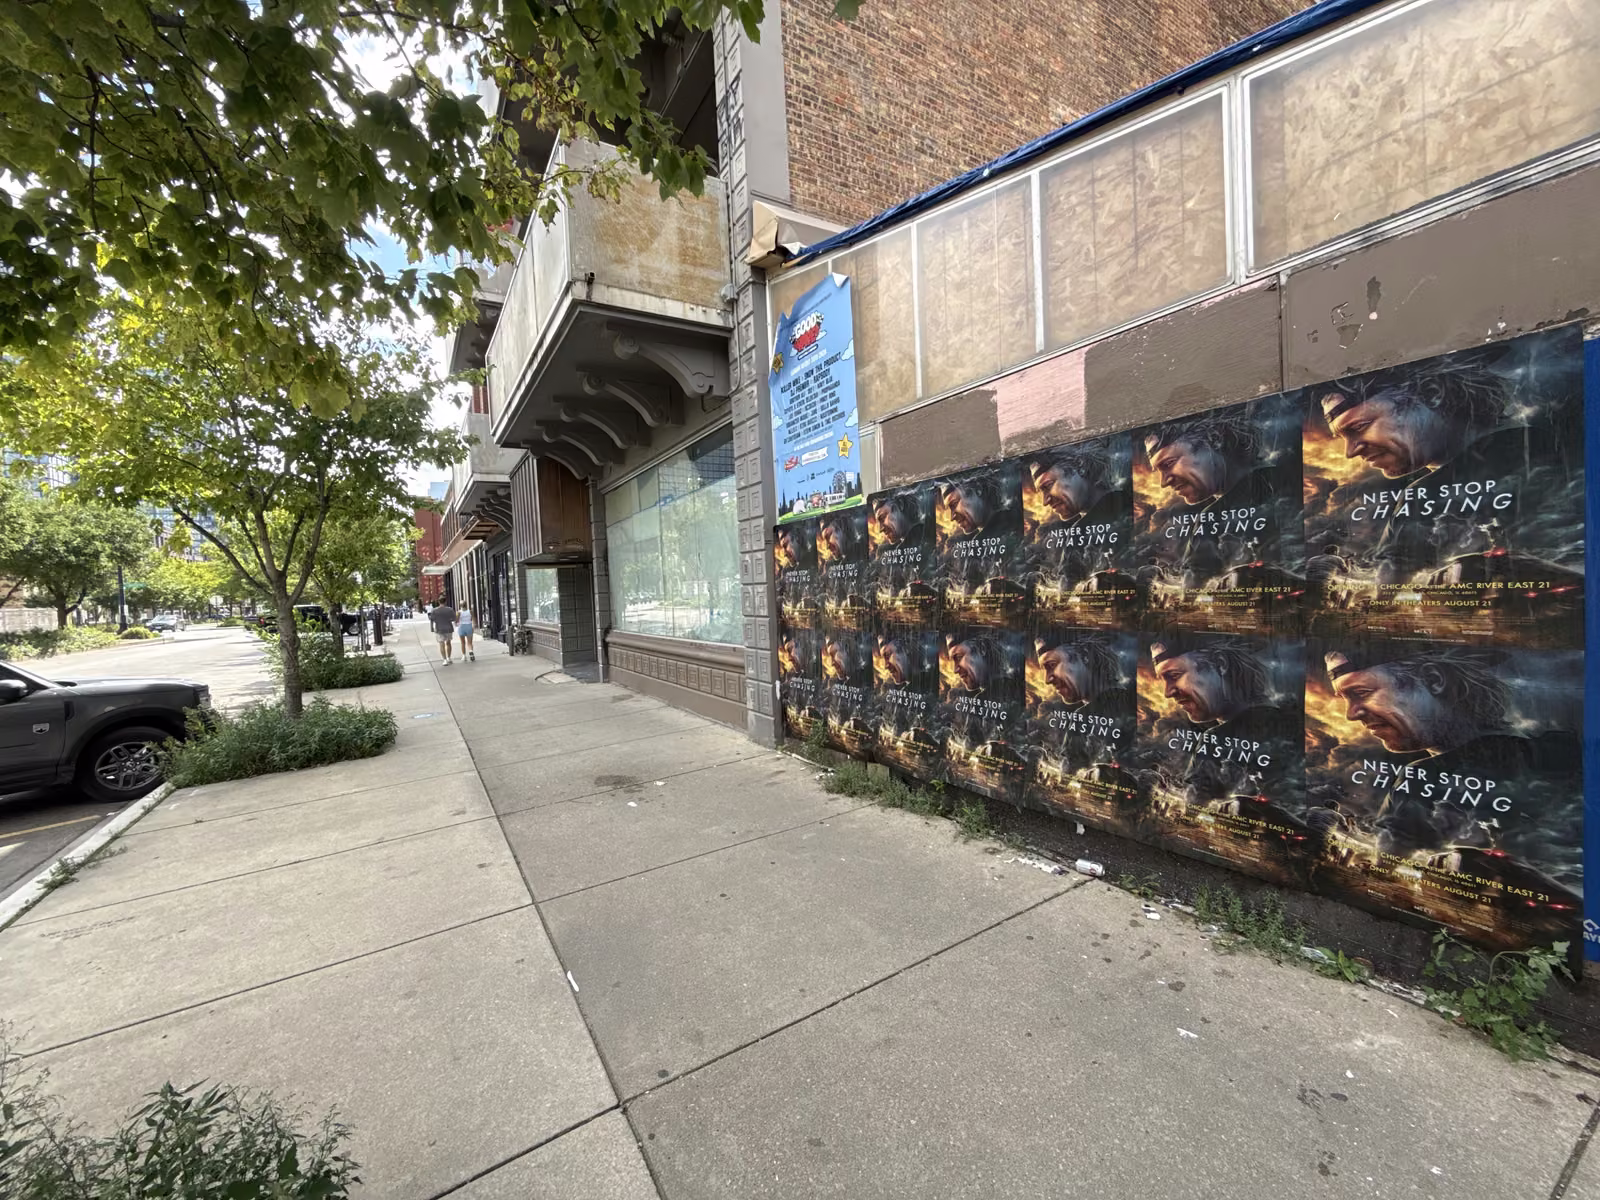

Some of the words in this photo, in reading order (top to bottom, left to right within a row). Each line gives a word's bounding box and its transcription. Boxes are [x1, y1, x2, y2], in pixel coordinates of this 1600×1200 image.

[796, 313, 816, 338] GOOD
[824, 352, 841, 368] PRODUCT
[1363, 487, 1427, 505] NEVER
[1439, 480, 1496, 497] STOP
[1351, 493, 1513, 521] CHASING
[1173, 512, 1215, 525] NEVER
[1221, 508, 1256, 520] STOP
[1051, 527, 1081, 537] NEVER
[1086, 524, 1110, 534] STOP
[1165, 518, 1266, 538] CHASING
[956, 540, 979, 548] NEVER
[982, 538, 1000, 546] STOP
[1046, 532, 1118, 548] CHASING
[881, 553, 922, 565] CHASING
[884, 549, 901, 557] NEVER
[904, 547, 918, 555] STOP
[953, 545, 1005, 558] CHASING
[828, 570, 858, 578] CHASING
[1508, 581, 1535, 589] EAST
[1538, 581, 1550, 589] 21
[790, 682, 816, 692] CHASING
[832, 689, 863, 701] CHASING
[888, 689, 907, 698] NEVER
[908, 692, 922, 700] STOP
[886, 694, 926, 709] CHASING
[960, 696, 981, 706] NEVER
[984, 700, 1001, 709] STOP
[955, 703, 1007, 720] CHASING
[1054, 710, 1083, 722] NEVER
[1088, 715, 1114, 726] STOP
[1049, 718, 1120, 738] CHASING
[1177, 728, 1217, 744] NEVER
[1225, 737, 1260, 751] STOP
[1168, 738, 1271, 767] CHASING
[1364, 758, 1428, 781] NEVER
[1439, 772, 1496, 792] STOP
[1351, 771, 1513, 812] CHASING
[1232, 815, 1247, 823] AMC
[1249, 819, 1267, 828] RIVER
[1269, 824, 1285, 832] EAST
[1229, 828, 1251, 837] AUGUST
[1370, 864, 1390, 874] ONLY
[1402, 874, 1441, 890] THEATERS
[1443, 886, 1479, 900] AUGUST
[1380, 852, 1422, 867] CHICAGO
[1449, 870, 1473, 881] AMC
[1476, 877, 1504, 890] RIVER
[1508, 885, 1535, 898] EAST
[1538, 893, 1549, 902] 21
